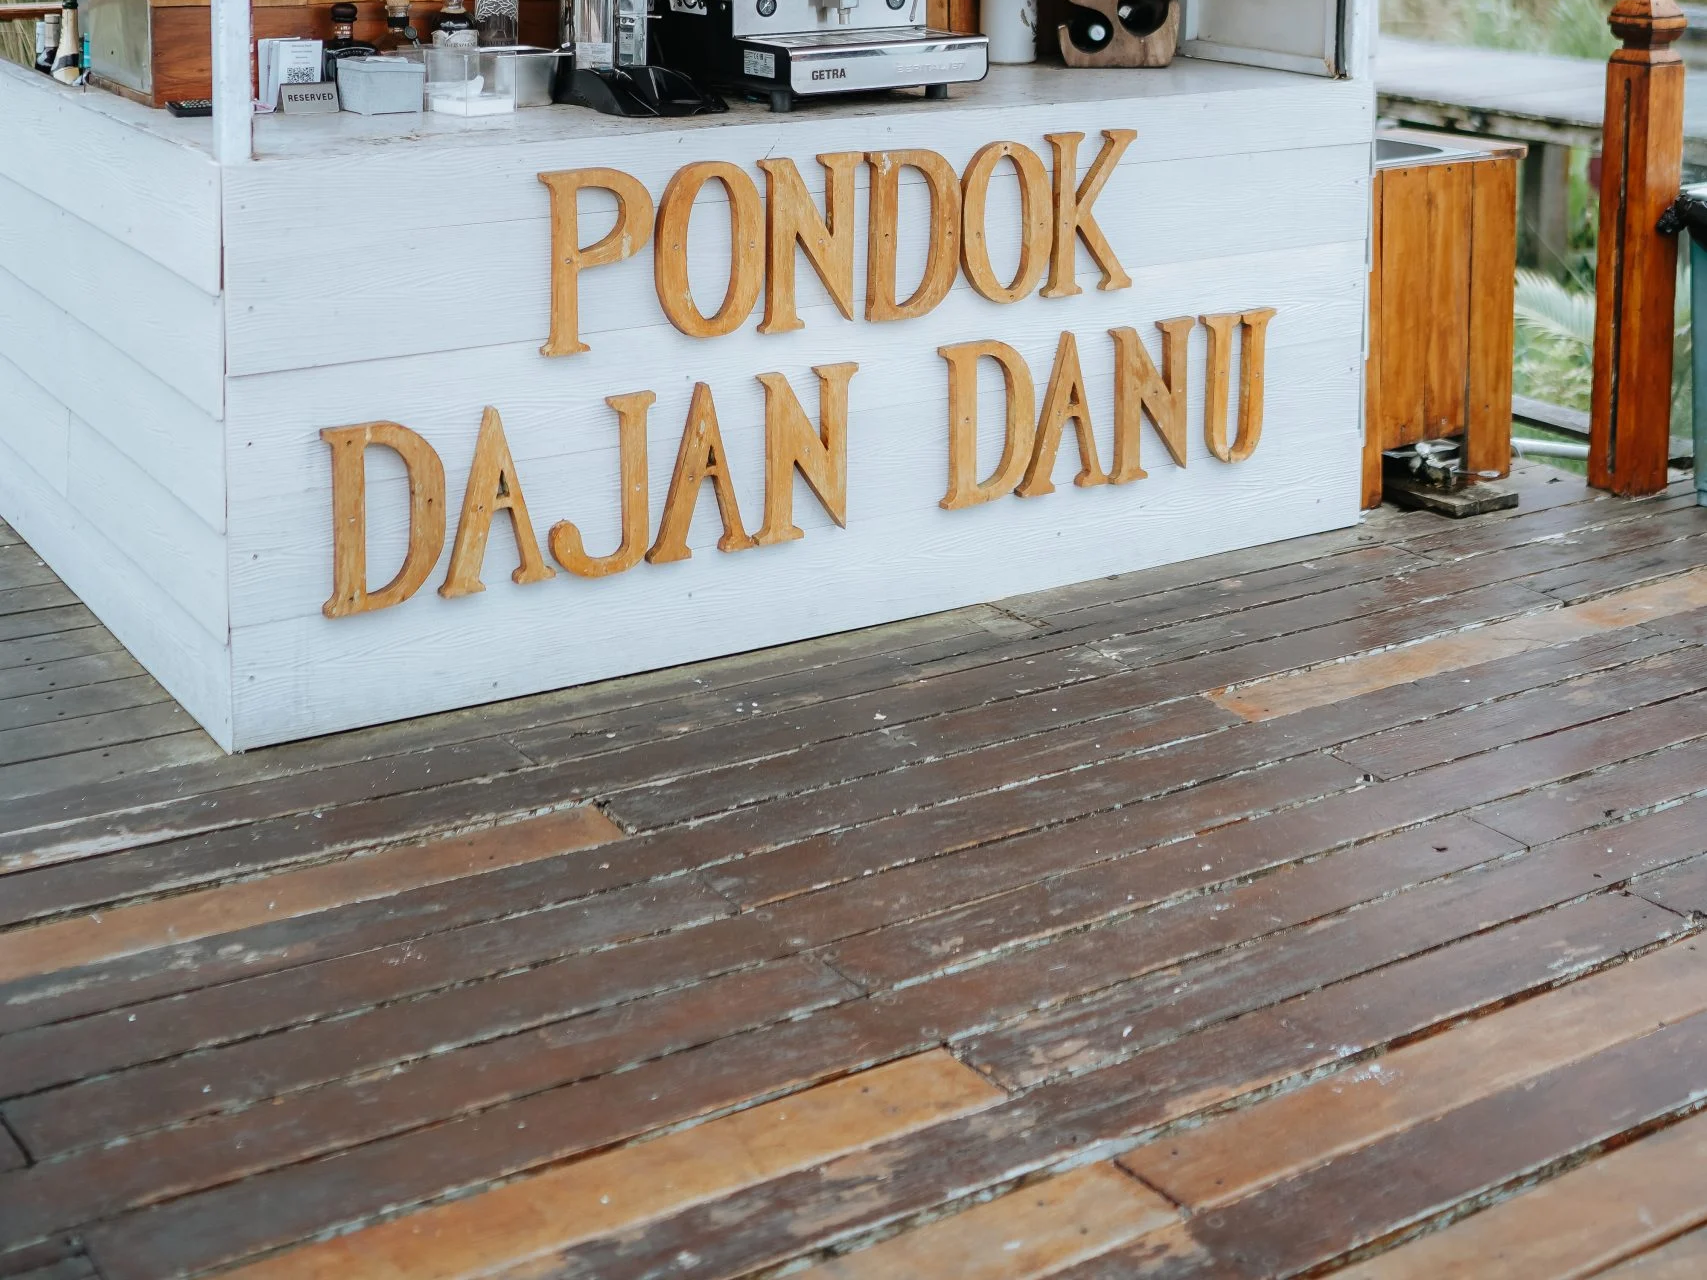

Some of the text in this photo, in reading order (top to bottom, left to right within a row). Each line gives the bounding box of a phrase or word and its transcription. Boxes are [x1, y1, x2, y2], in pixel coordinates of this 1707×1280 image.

[287, 93, 334, 102] RESERVED
[811, 68, 847, 80] GETRA
[537, 128, 1138, 357] PONDOK
[318, 307, 1277, 619] DAJAN DANU
